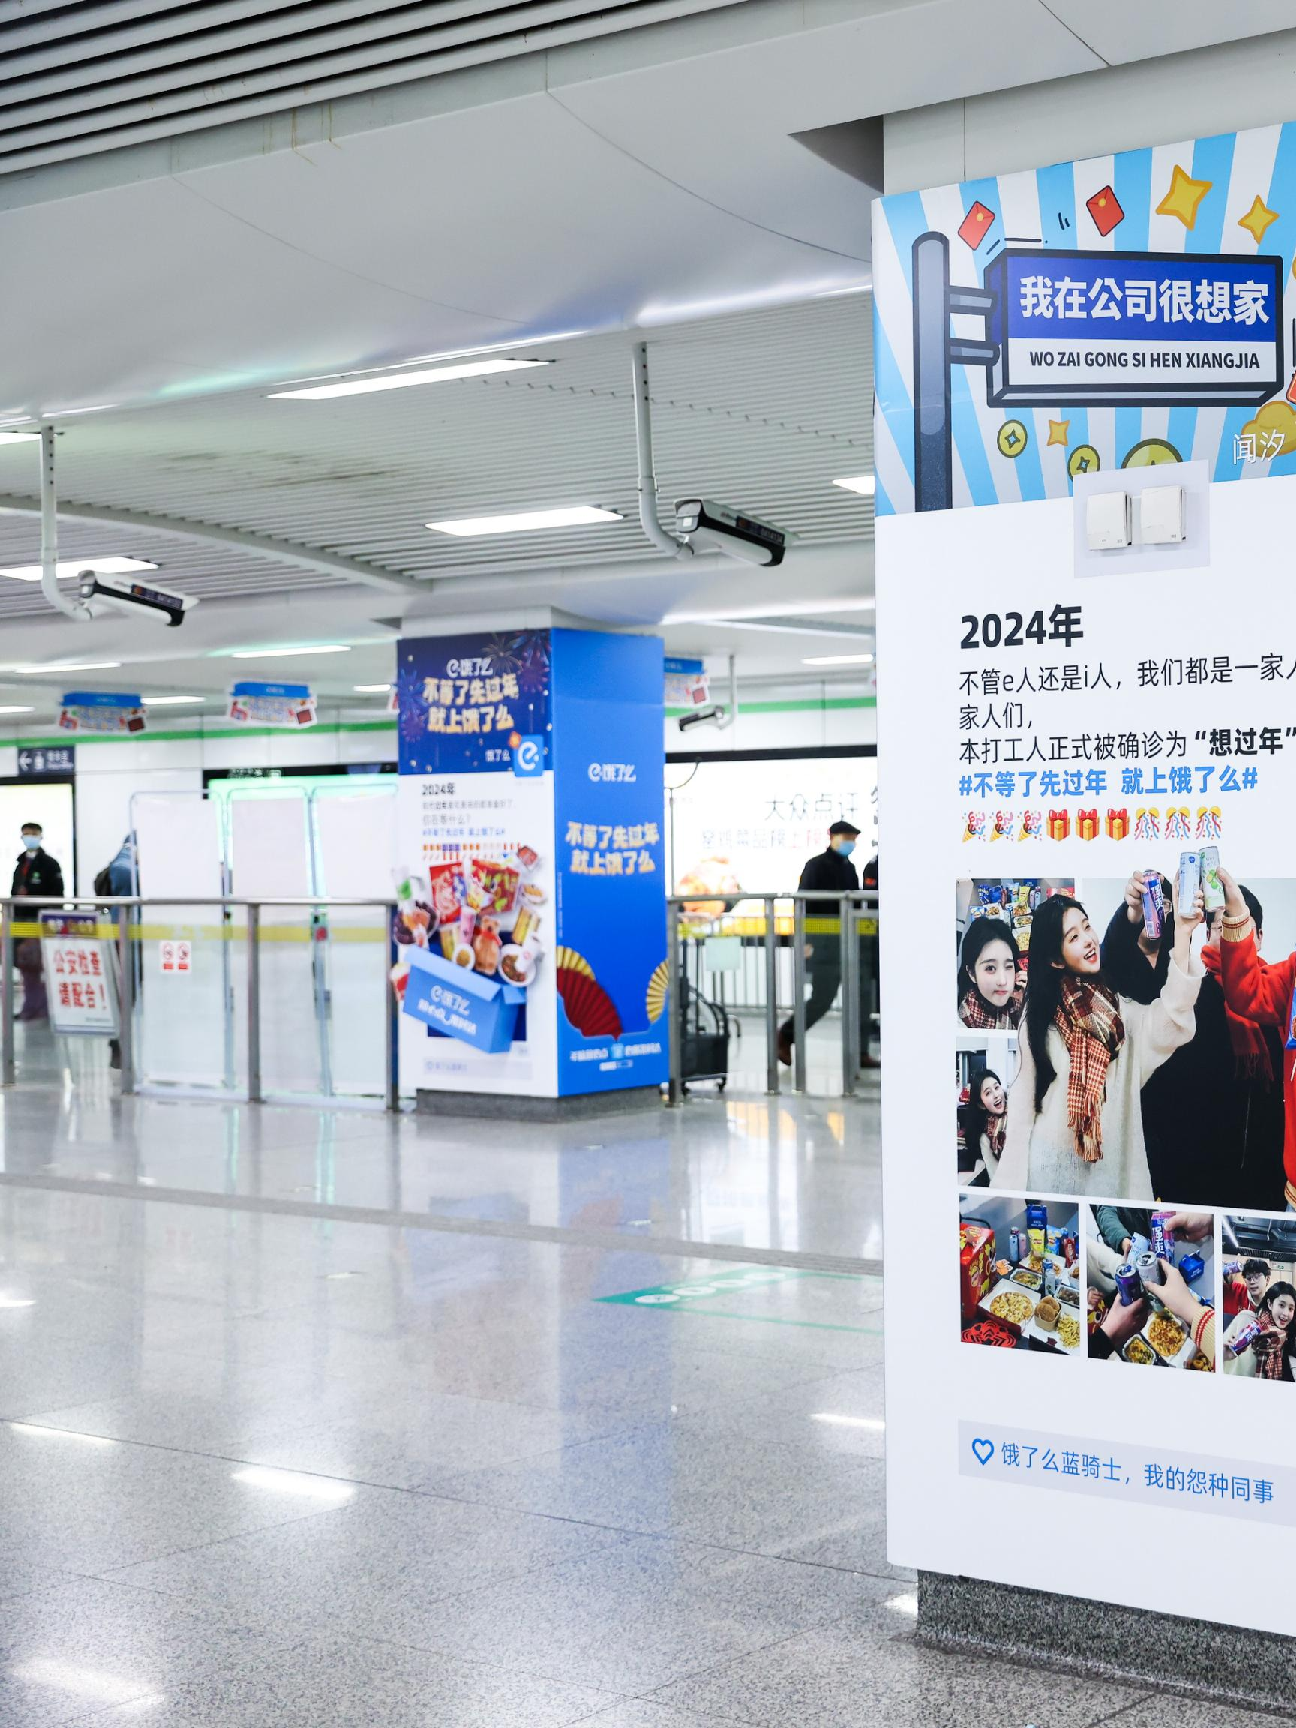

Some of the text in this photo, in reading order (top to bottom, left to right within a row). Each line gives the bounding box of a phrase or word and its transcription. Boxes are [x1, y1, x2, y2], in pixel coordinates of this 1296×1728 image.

[1020, 275, 1270, 326] 我在公司很想家
[1029, 351, 1260, 370] WO ZAI GONG SI HEN XIANGJIA
[1233, 429, 1286, 465] 闻汐
[960, 604, 1084, 650] 2024年
[423, 673, 519, 705] 不等了先过年
[427, 704, 514, 734] 就上饿了么
[959, 765, 1258, 798] #不等了先过年 就上饿了么#
[565, 820, 659, 849] 不等了先过年
[569, 851, 655, 876] 就上饿了么
[1000, 1442, 1275, 1504] 饿了么蓝骑士，我的怨种同事
